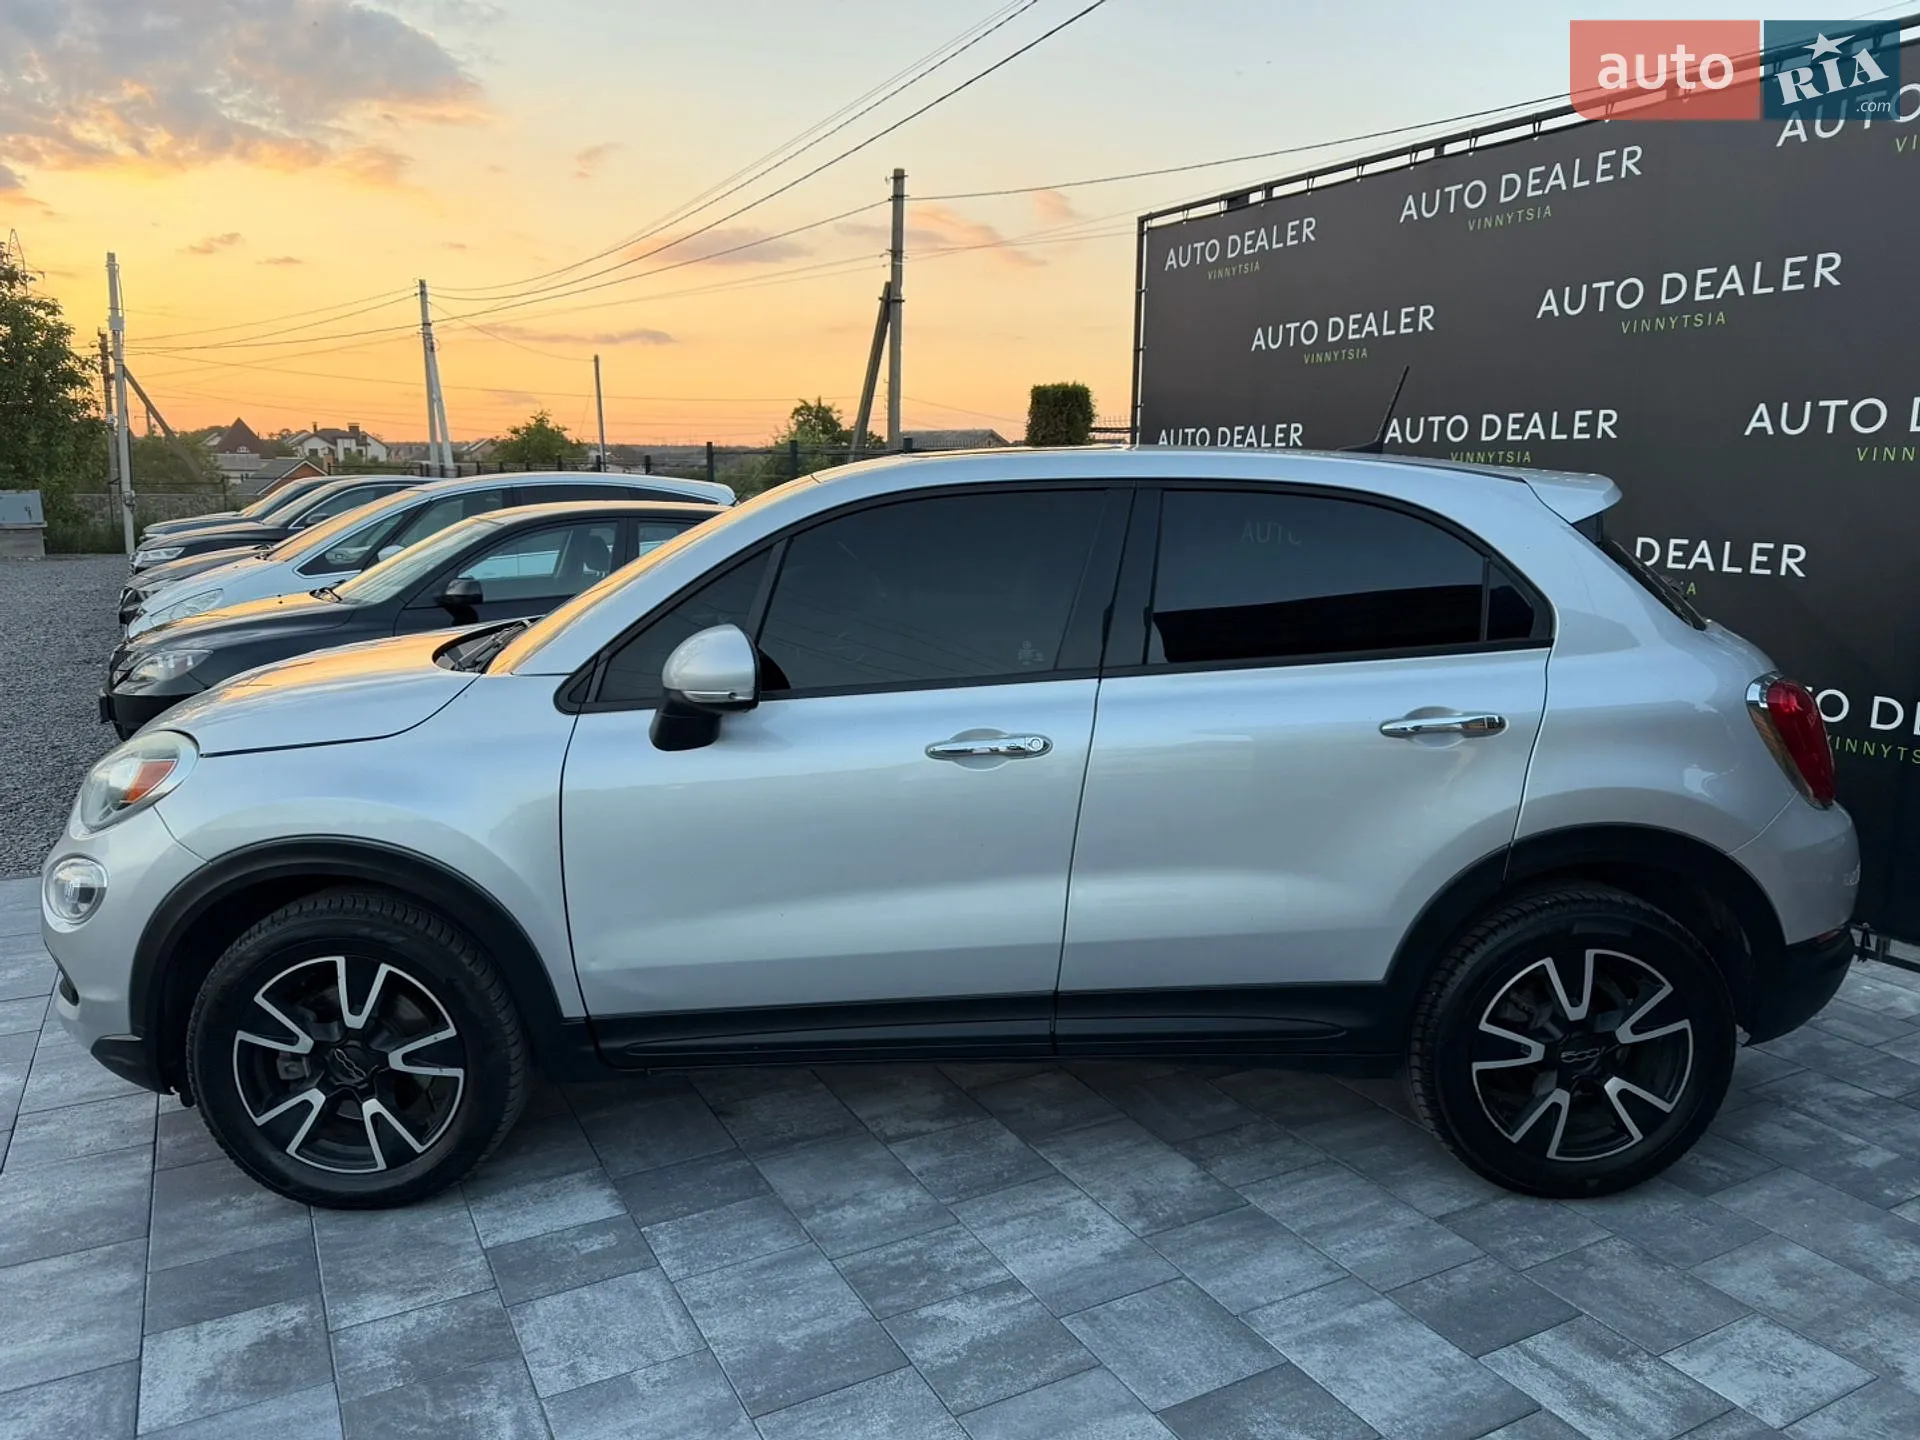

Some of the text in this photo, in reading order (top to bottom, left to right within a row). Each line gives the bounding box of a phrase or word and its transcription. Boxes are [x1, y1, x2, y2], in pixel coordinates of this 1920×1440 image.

[1776, 82, 1920, 147] AUTO
[1399, 144, 1643, 224] AUTO DEALER
[1467, 205, 1553, 232] VINNYTSIA
[1164, 216, 1317, 272] AUTO DEALER
[1206, 261, 1261, 281] VINNYTSIA
[1536, 251, 1843, 319] AUTO DEALER
[1251, 304, 1436, 352] AUTO DEALER
[1621, 311, 1727, 334] VINNYTSIA
[1303, 347, 1369, 365] VINNYTSIA
[1158, 423, 1304, 448] AUTO DEALER
[1384, 408, 1619, 445] AUTO DEALER
[1744, 397, 1888, 436] AUTO
[1450, 450, 1532, 464] VINNYTSIA
[1635, 536, 1807, 577] DEALER
